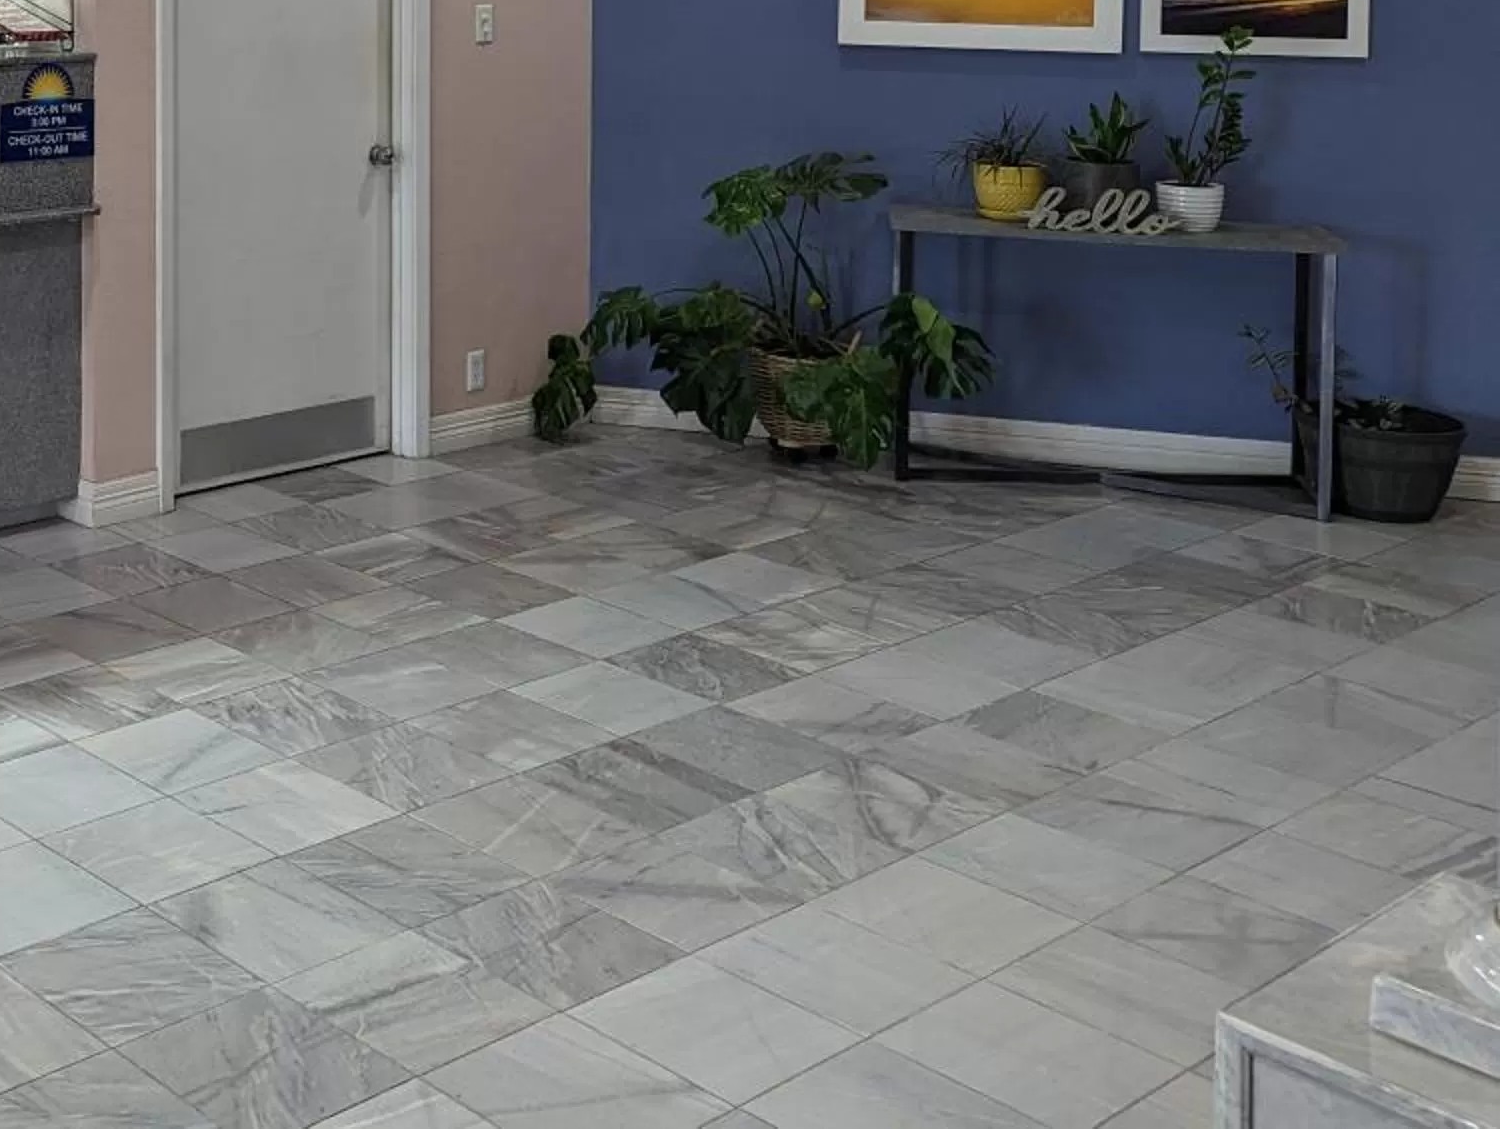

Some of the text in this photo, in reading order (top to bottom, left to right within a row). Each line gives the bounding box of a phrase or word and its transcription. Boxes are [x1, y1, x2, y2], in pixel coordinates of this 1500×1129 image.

[13, 102, 83, 116] CHECK-IN TIME
[51, 115, 67, 125] PM
[7, 130, 89, 146] CHECK-OUT TIME
[27, 144, 69, 157] 11:00 AM
[1018, 185, 1184, 235] hello
